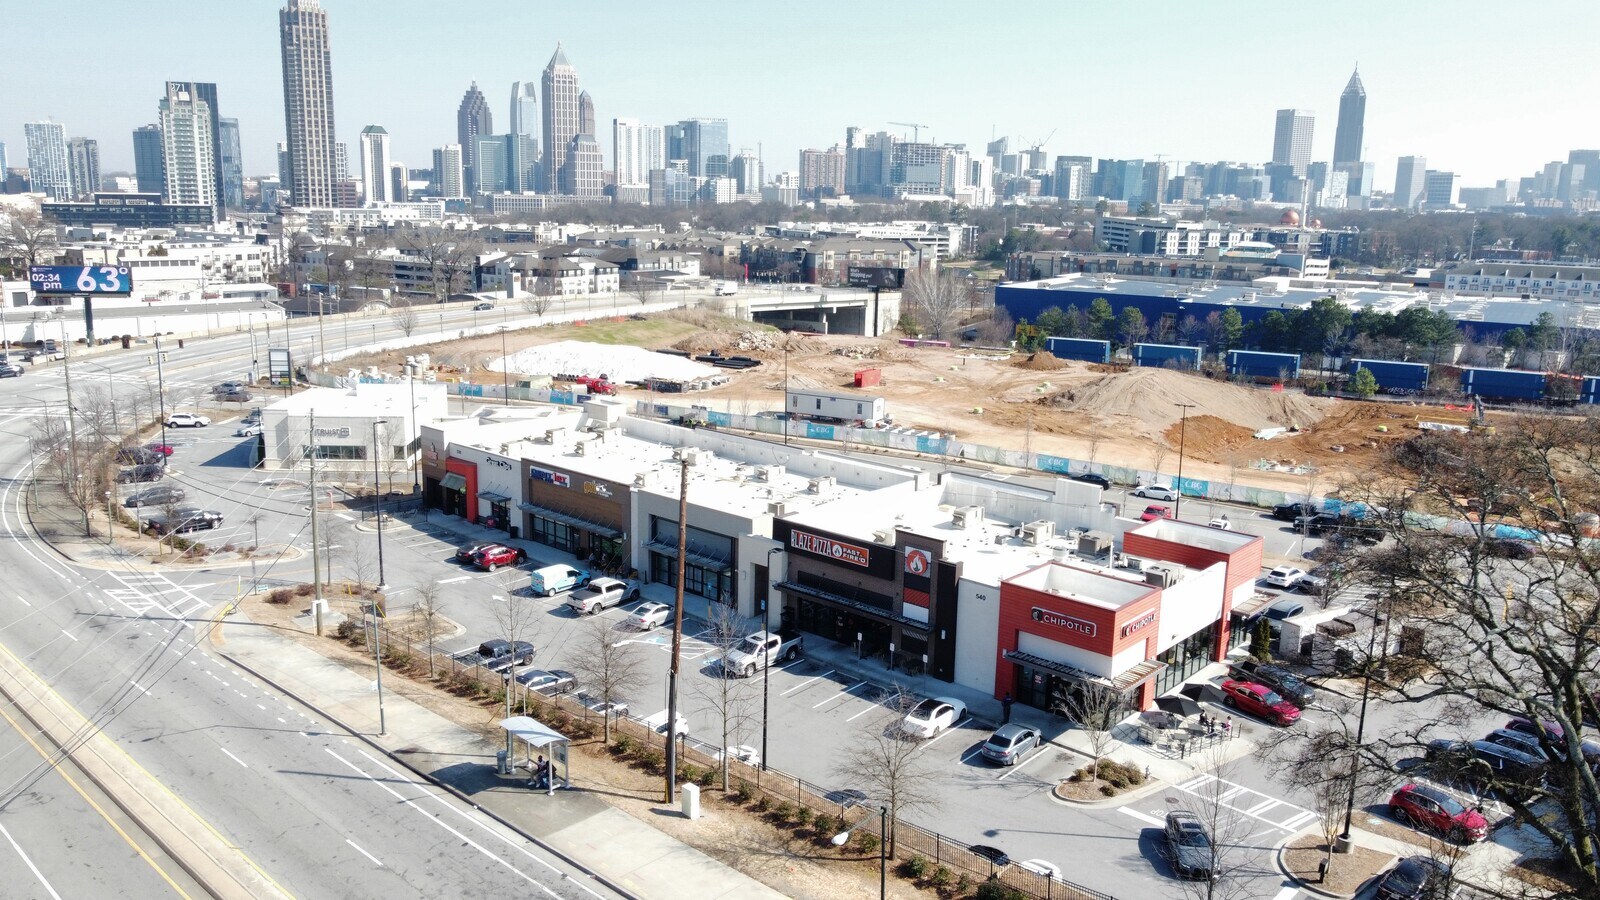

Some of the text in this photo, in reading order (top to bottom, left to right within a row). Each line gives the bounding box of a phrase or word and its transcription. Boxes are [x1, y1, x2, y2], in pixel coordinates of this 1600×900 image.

[32, 273, 60, 282] 02:34
[43, 281, 62, 290] pm
[316, 428, 340, 436] TRUIST
[791, 531, 832, 556] BLAZE PIZZA
[976, 593, 987, 601] 540
[1044, 614, 1091, 634] CHIPOTLE
[1131, 613, 1156, 632] CHIPOTLE
